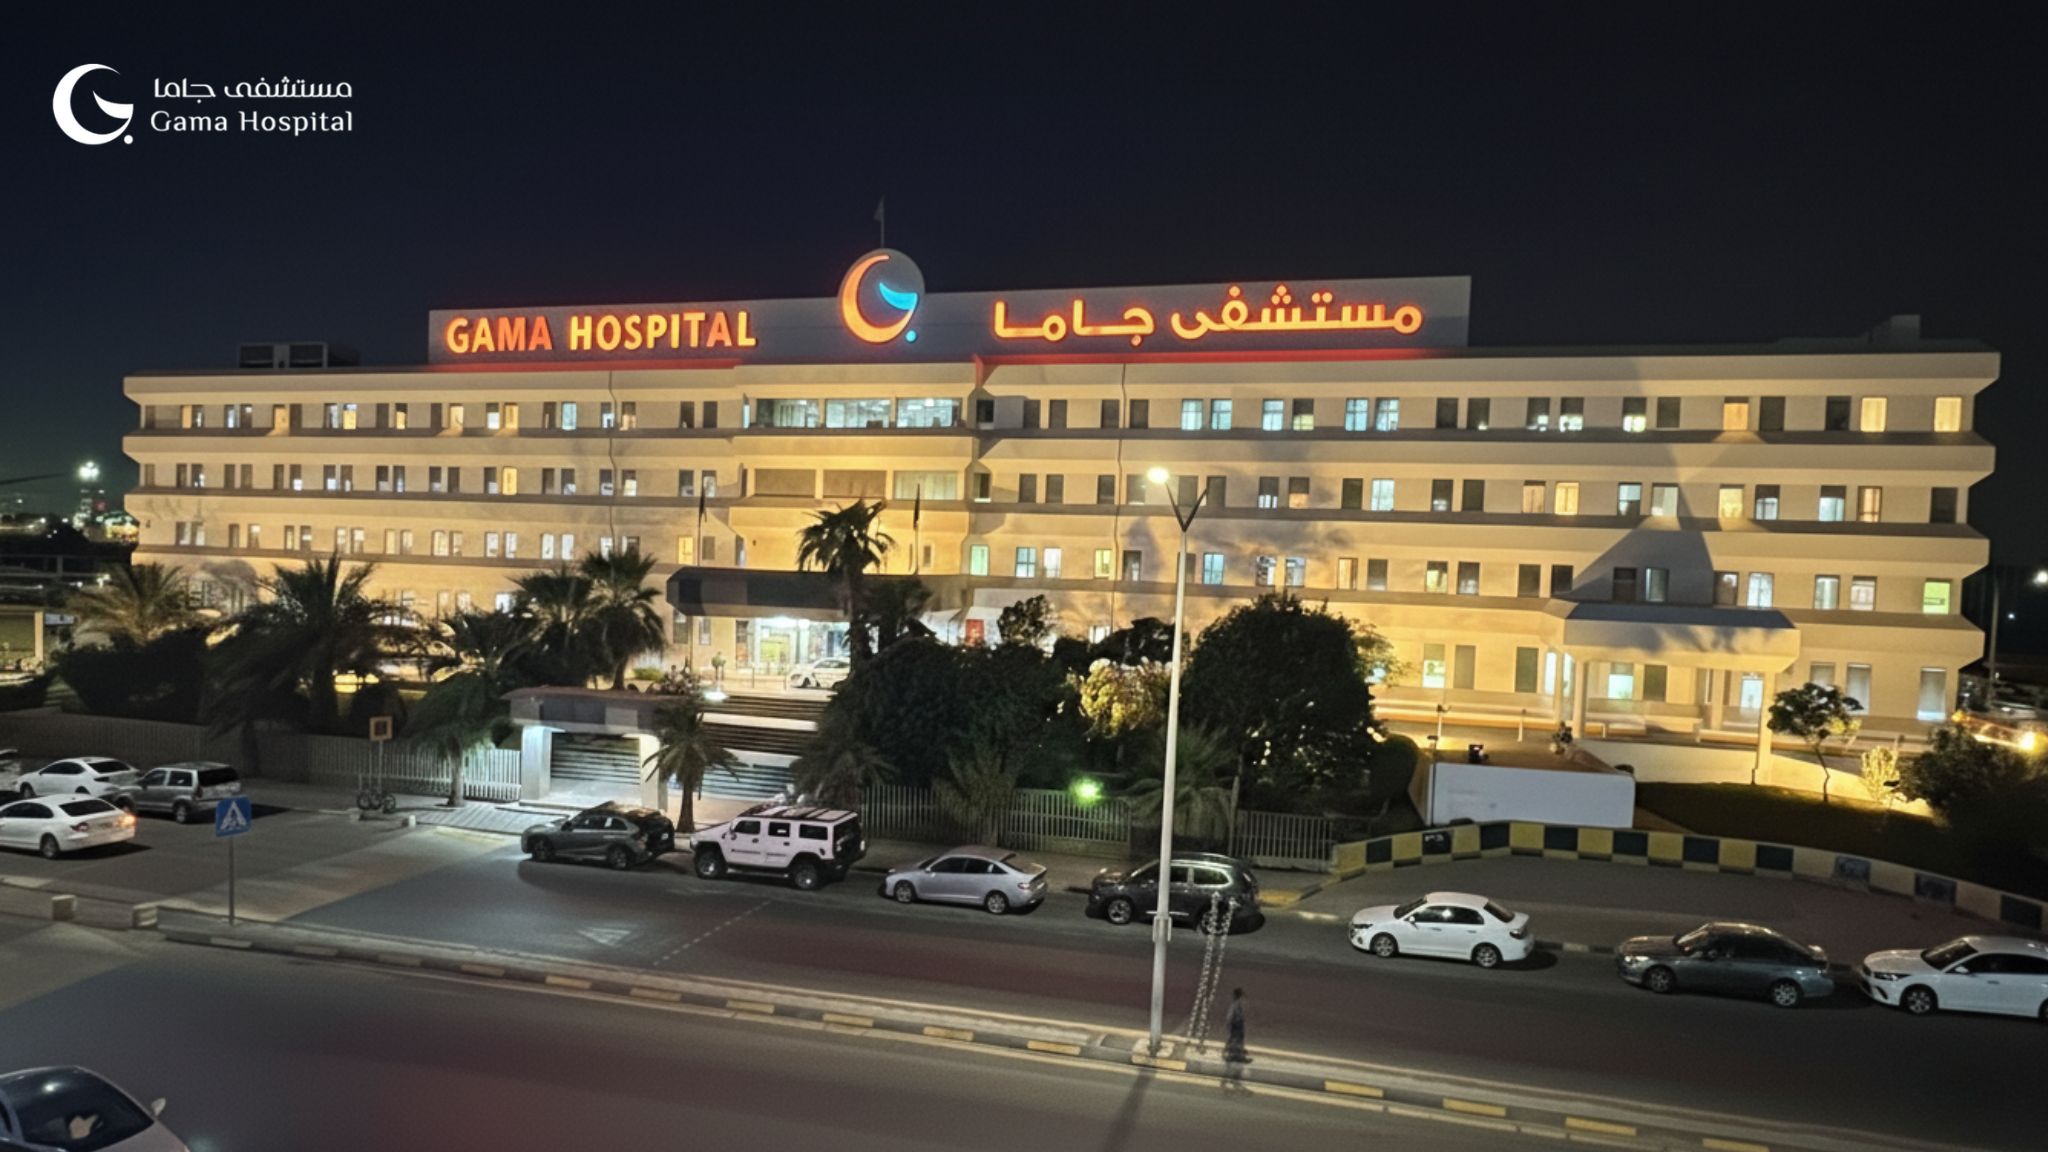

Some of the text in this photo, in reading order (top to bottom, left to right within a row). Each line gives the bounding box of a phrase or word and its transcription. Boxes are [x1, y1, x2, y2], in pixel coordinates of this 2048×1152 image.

[445, 311, 757, 354] GAMA HOSPITAL
[993, 284, 1423, 346] مستشفى جاما
